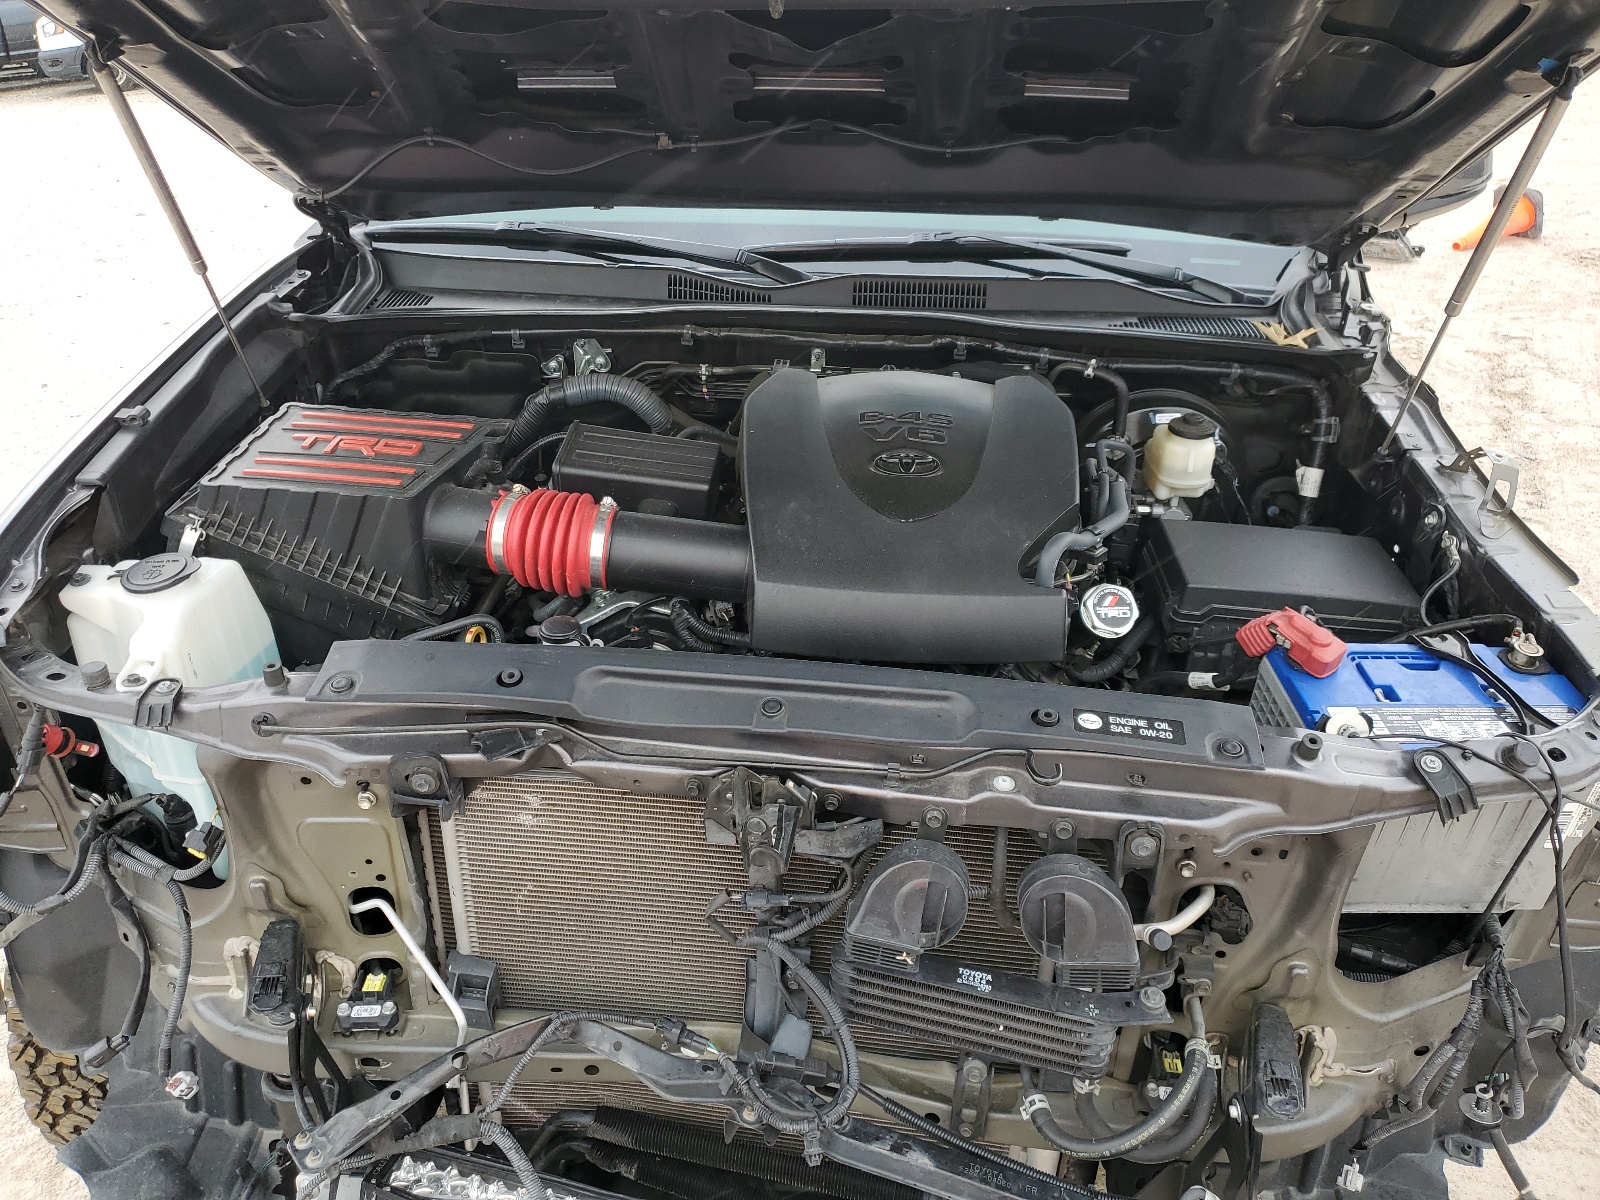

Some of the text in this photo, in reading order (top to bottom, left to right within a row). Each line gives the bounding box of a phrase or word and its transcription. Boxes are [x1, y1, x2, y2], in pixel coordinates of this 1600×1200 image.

[860, 425, 948, 445] V6
[291, 432, 424, 458] TRD
[1095, 607, 1131, 619] TRD
[1108, 716, 1149, 728] ENGINE
[1154, 721, 1174, 731] OIL
[1110, 724, 1174, 740] SAE 0W-20
[958, 967, 993, 982] TOYOTA
[969, 1162, 1004, 1180] TOYOTA
[1025, 1184, 1038, 1196] FR
